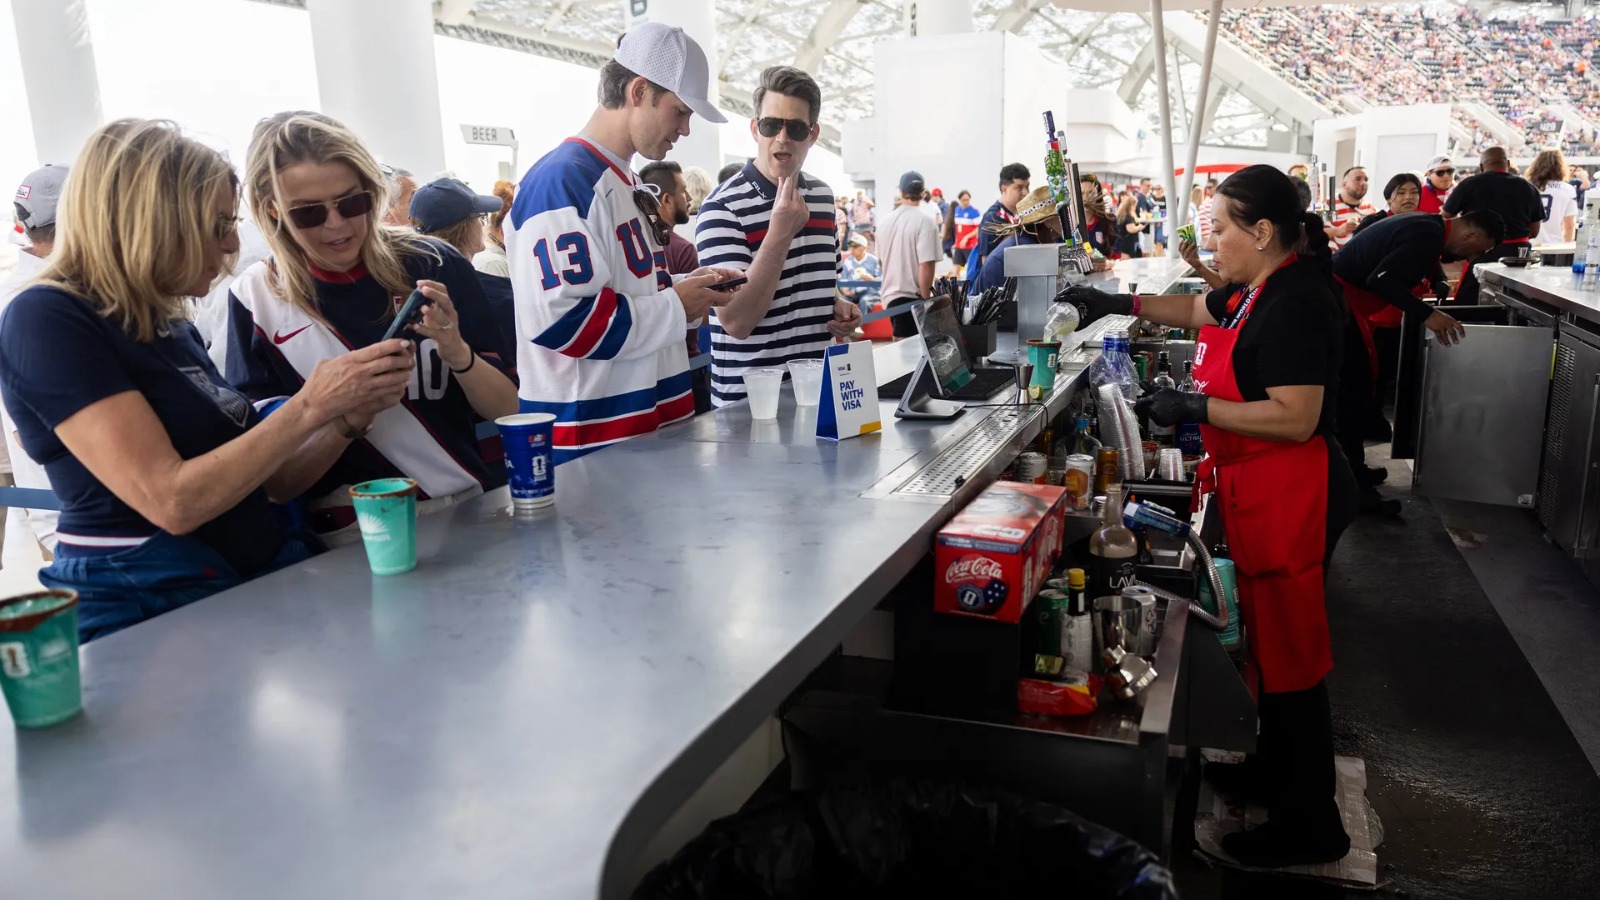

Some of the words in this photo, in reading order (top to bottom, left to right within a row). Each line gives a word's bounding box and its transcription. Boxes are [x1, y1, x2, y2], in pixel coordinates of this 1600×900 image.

[472, 126, 497, 141] BEER
[751, 181, 767, 199] RLX
[533, 231, 594, 291] 13
[1236, 298, 1250, 318] WORLD
[839, 380, 855, 391] PAY
[840, 388, 864, 402] WITH
[842, 399, 862, 412] VISA
